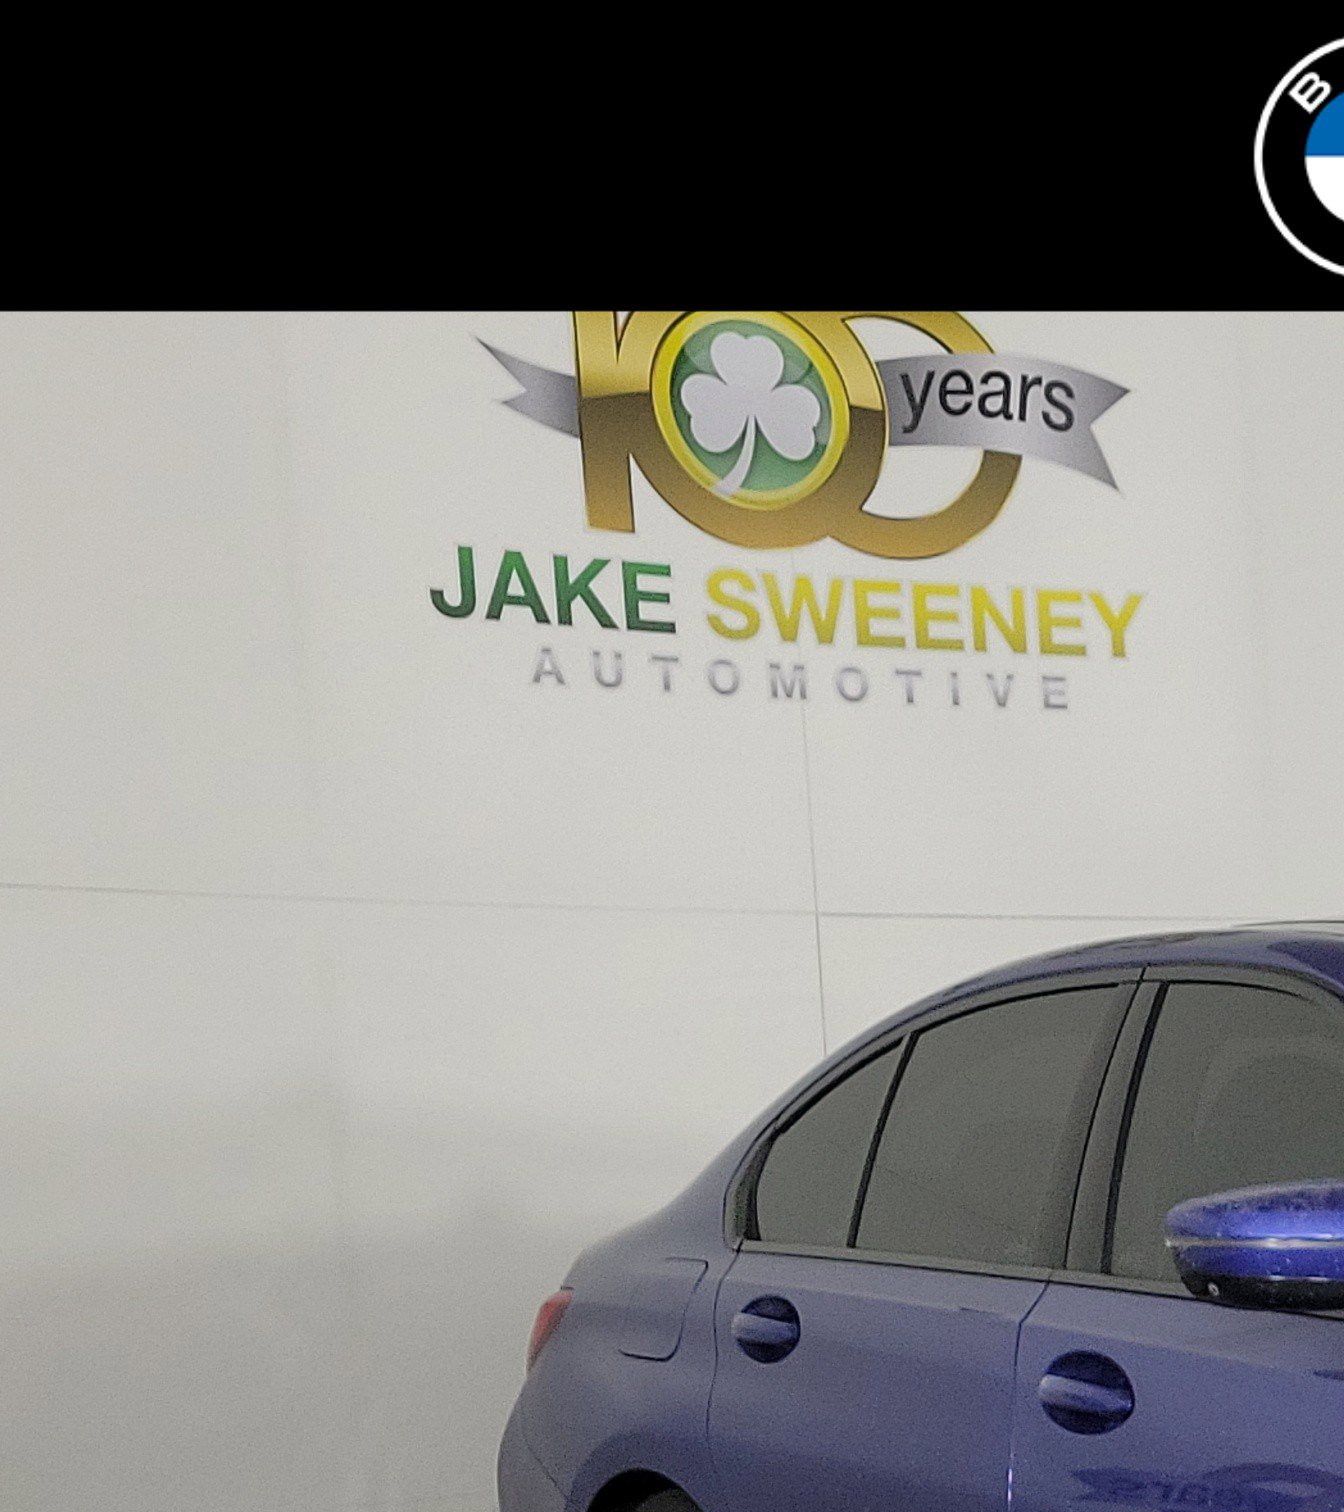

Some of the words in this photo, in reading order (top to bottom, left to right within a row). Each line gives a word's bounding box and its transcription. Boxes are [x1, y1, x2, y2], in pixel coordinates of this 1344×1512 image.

[899, 369, 1076, 434] years
[430, 545, 677, 634] JAKE
[705, 568, 1144, 659] SWEENEY
[532, 647, 1070, 711] AUTOMOTIVE
